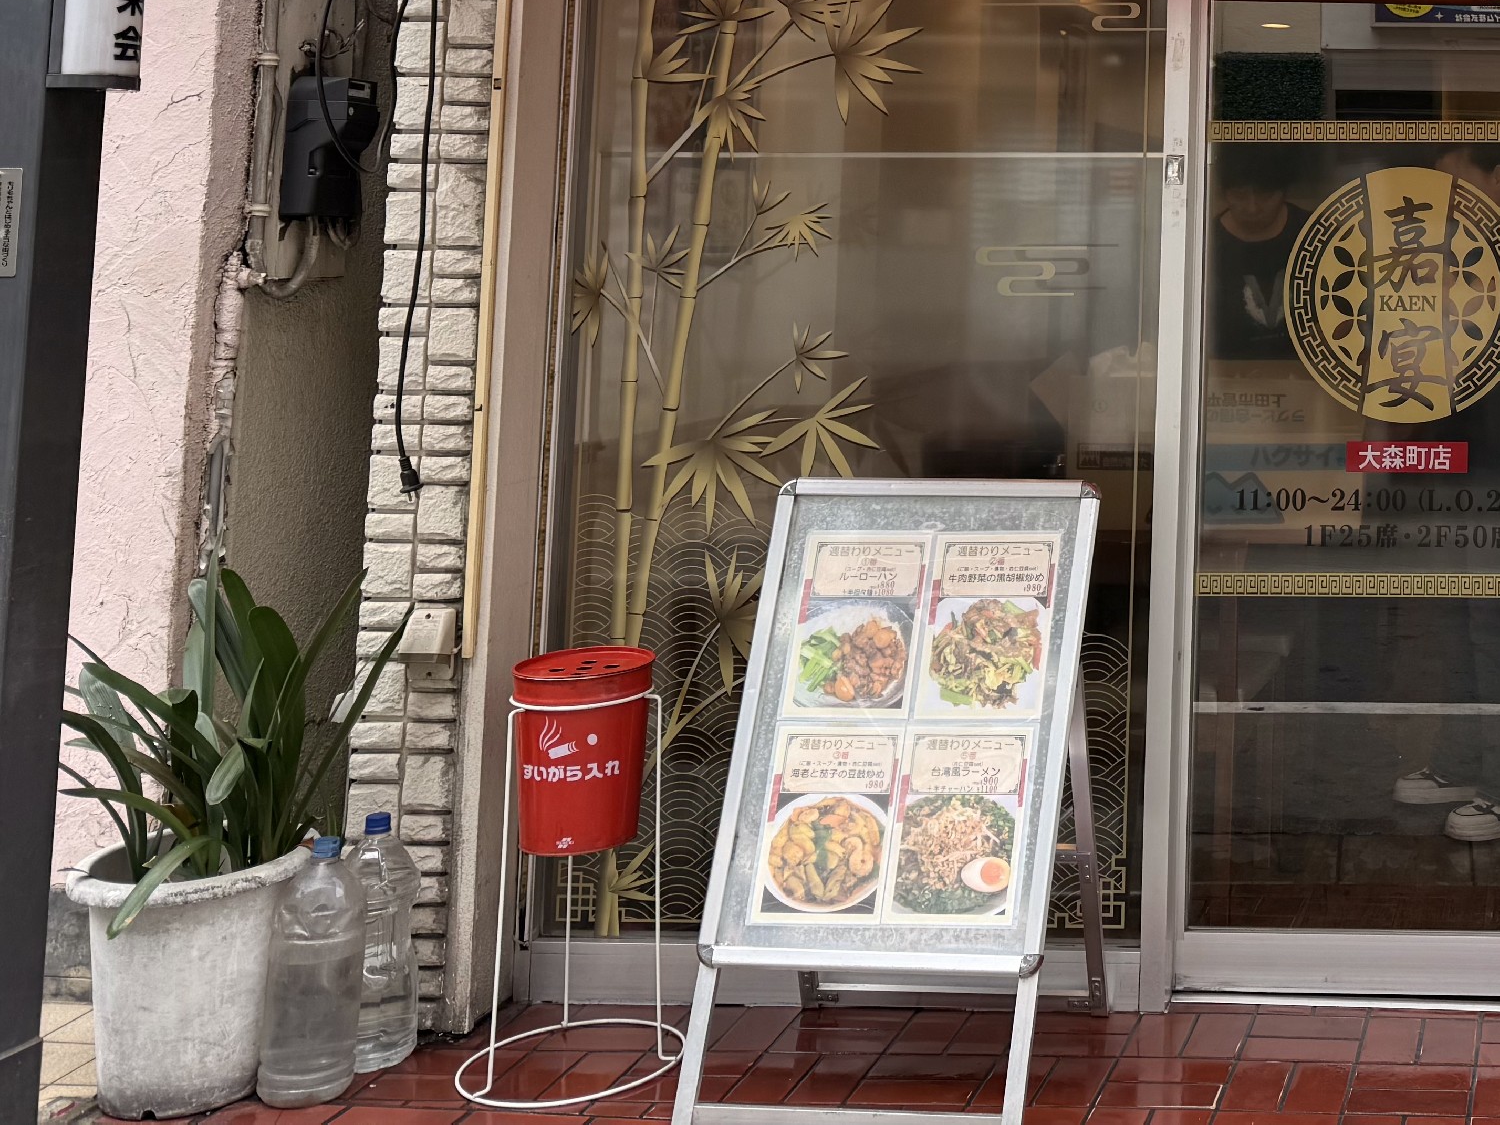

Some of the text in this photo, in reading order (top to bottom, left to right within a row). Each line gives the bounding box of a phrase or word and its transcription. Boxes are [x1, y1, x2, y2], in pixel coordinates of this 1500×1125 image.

[1378, 294, 1437, 313] KAEN
[1358, 443, 1453, 471] 大森町店
[957, 545, 1043, 557] 週替わりメニュー
[839, 572, 898, 581] ルーローハン
[522, 759, 620, 783] すいがら入れ
[931, 766, 1001, 777] 台湾風ラーメン
